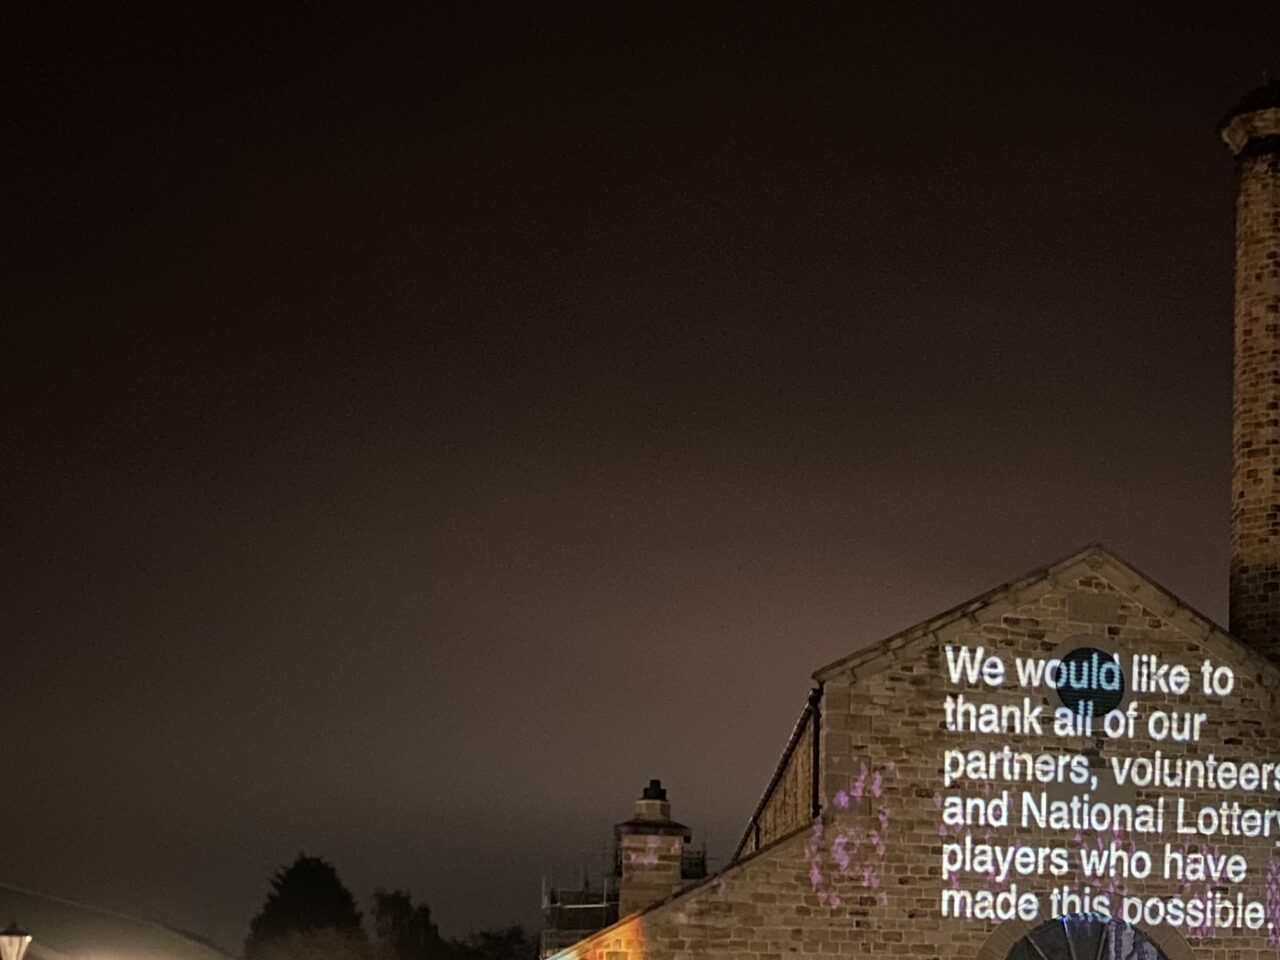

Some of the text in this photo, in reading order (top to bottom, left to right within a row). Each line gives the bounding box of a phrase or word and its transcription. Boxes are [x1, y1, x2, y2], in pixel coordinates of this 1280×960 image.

[945, 645, 1234, 696] We would like to
[943, 695, 1207, 741] thank all of our
[944, 746, 1098, 790] partners,
[942, 793, 1008, 828] and
[1021, 791, 1164, 833] National
[942, 837, 1247, 883] players who have
[941, 884, 1275, 930] made this possible.
